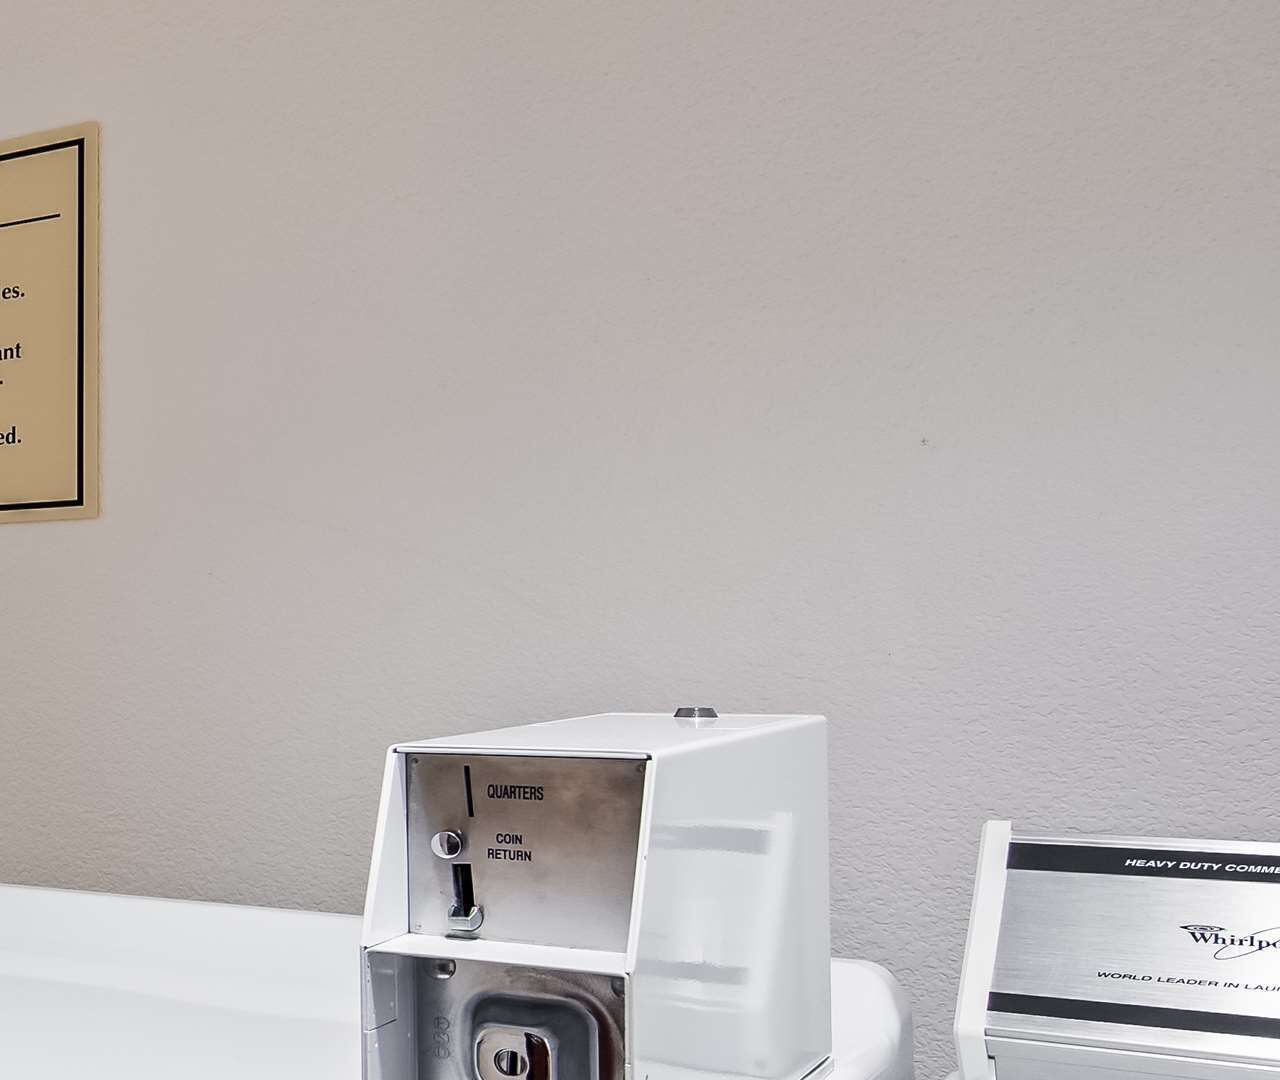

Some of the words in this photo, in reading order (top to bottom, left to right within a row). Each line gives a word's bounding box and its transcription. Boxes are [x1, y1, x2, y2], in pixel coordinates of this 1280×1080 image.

[487, 784, 544, 801] QUARTERS
[496, 833, 522, 845] COIN
[487, 848, 532, 862] RETURN
[1124, 859, 1177, 869] HEAVY
[1179, 862, 1222, 872] DUTY
[1097, 971, 1153, 982] WORLD
[1157, 976, 1219, 987] LEADER
[1244, 984, 1280, 992] LAU
